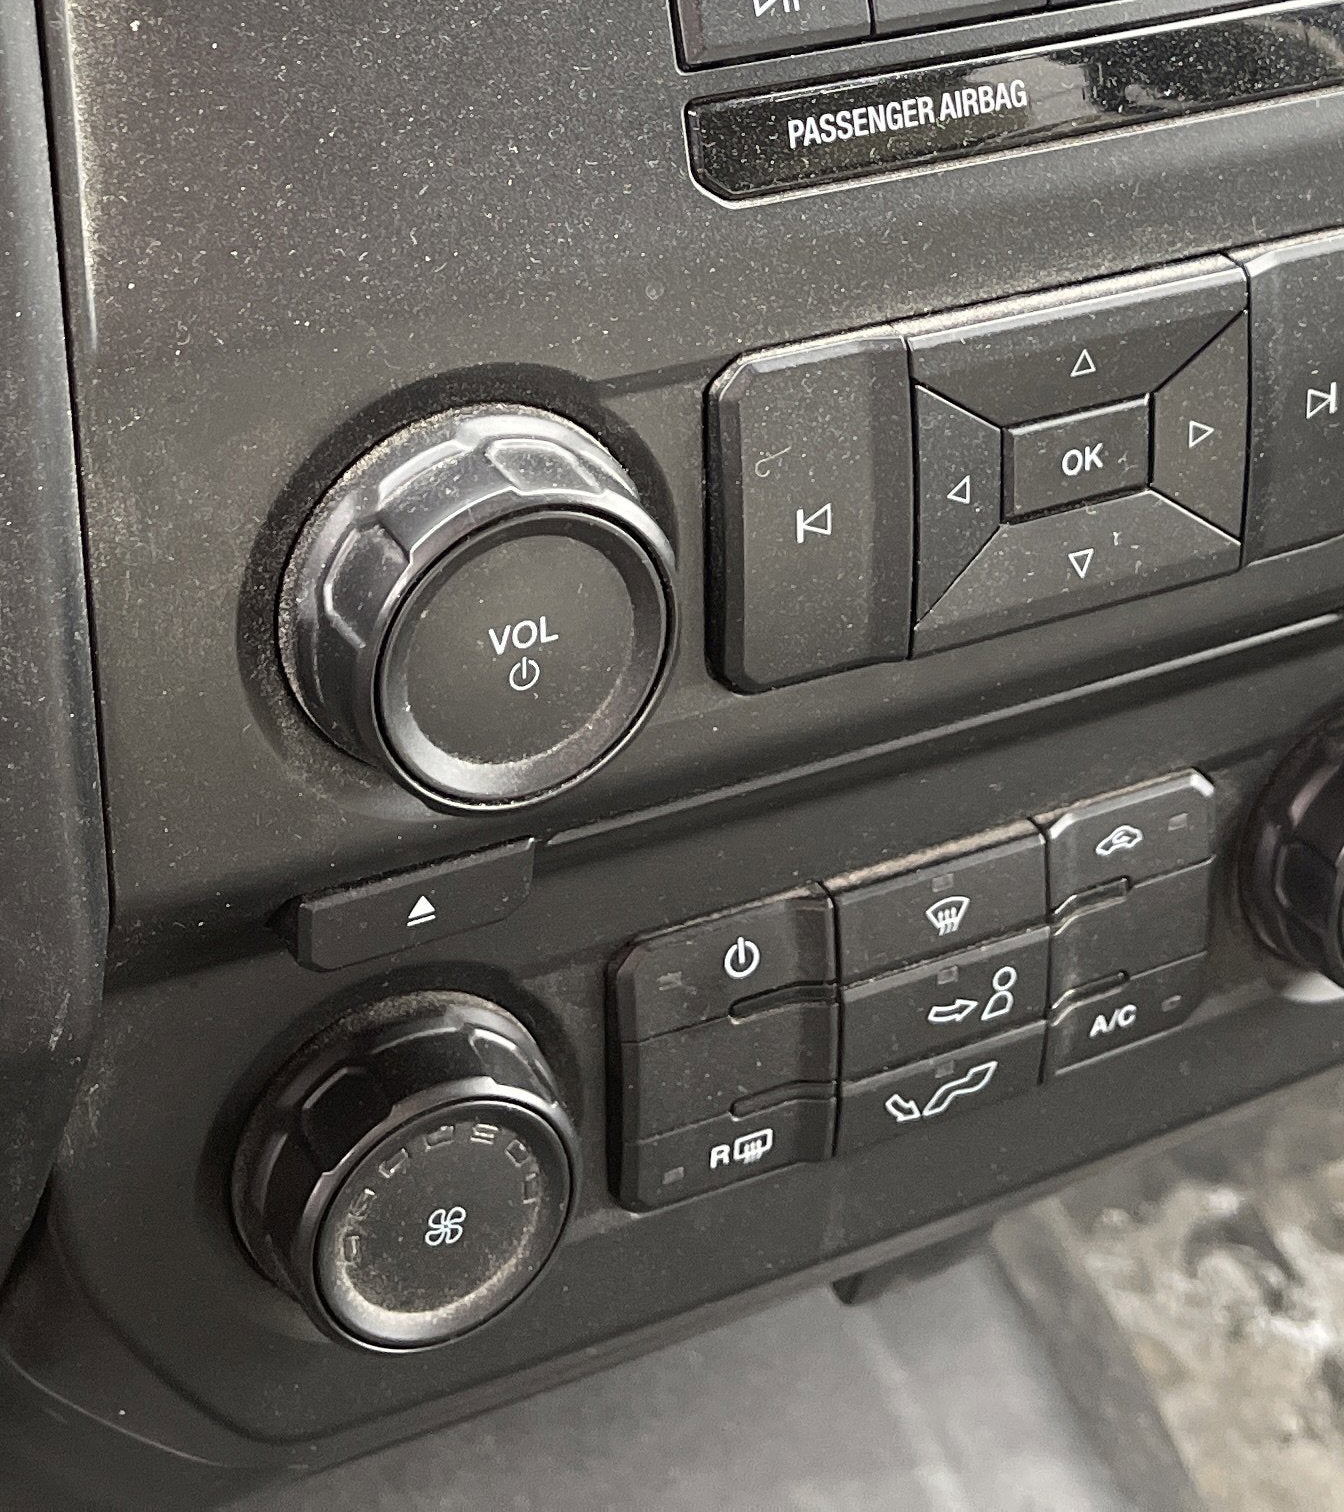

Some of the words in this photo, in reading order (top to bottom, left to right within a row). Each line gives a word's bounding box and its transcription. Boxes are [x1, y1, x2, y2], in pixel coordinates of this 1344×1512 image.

[788, 96, 935, 149] PASSENGER
[940, 80, 1028, 121] AIRBAG
[1062, 443, 1103, 476] OK
[488, 616, 559, 655] VOL
[1089, 1004, 1137, 1038] A/C
[710, 1144, 730, 1169] R
